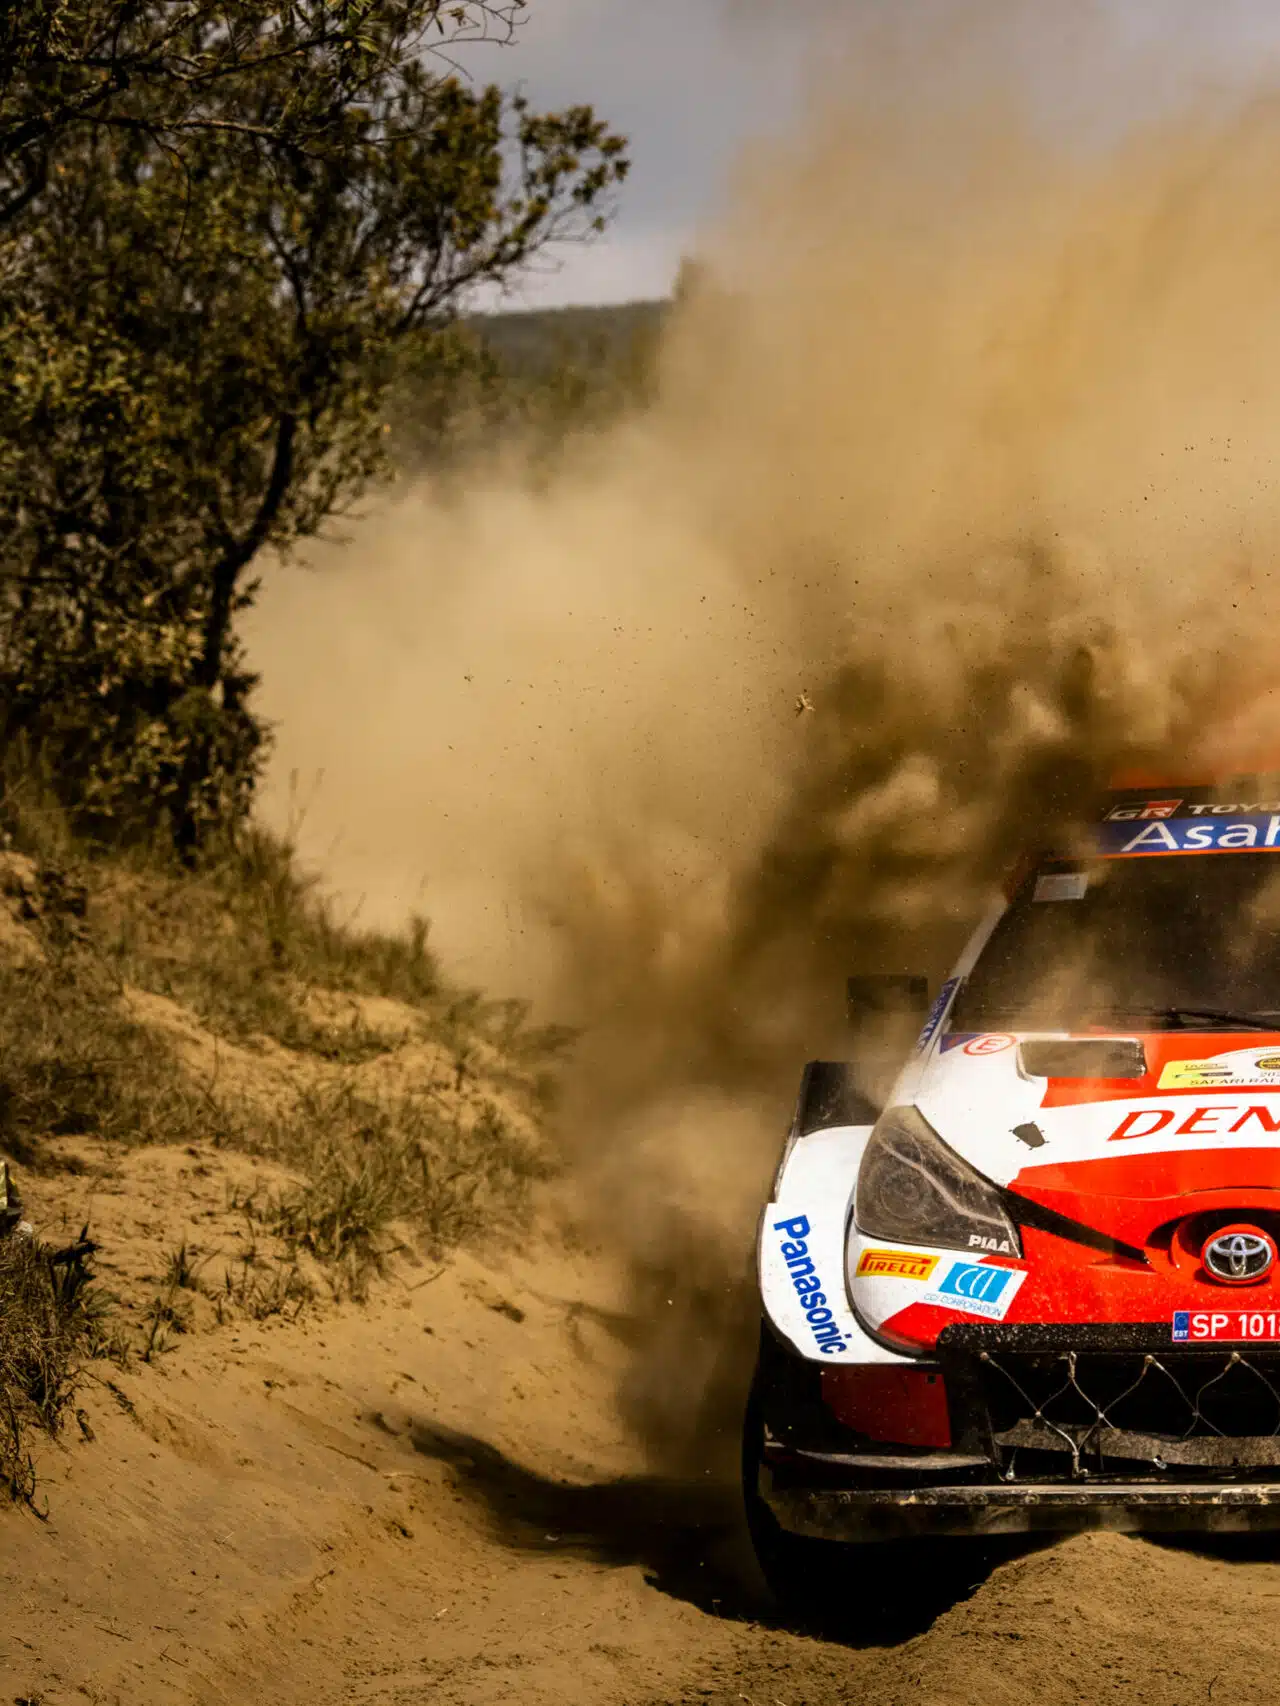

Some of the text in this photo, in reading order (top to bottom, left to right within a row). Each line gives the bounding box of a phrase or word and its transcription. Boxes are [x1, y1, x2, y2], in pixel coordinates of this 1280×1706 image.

[1109, 805, 1173, 821] GR
[1190, 1078, 1246, 1086] SAFARI
[967, 1234, 1010, 1252] PIAA
[860, 1252, 932, 1276] PIRELLI
[773, 1214, 853, 1354] Panasonic
[940, 1294, 1002, 1317] CORPORATION
[1174, 1329, 1189, 1338] EST
[1191, 1313, 1229, 1338] SP
